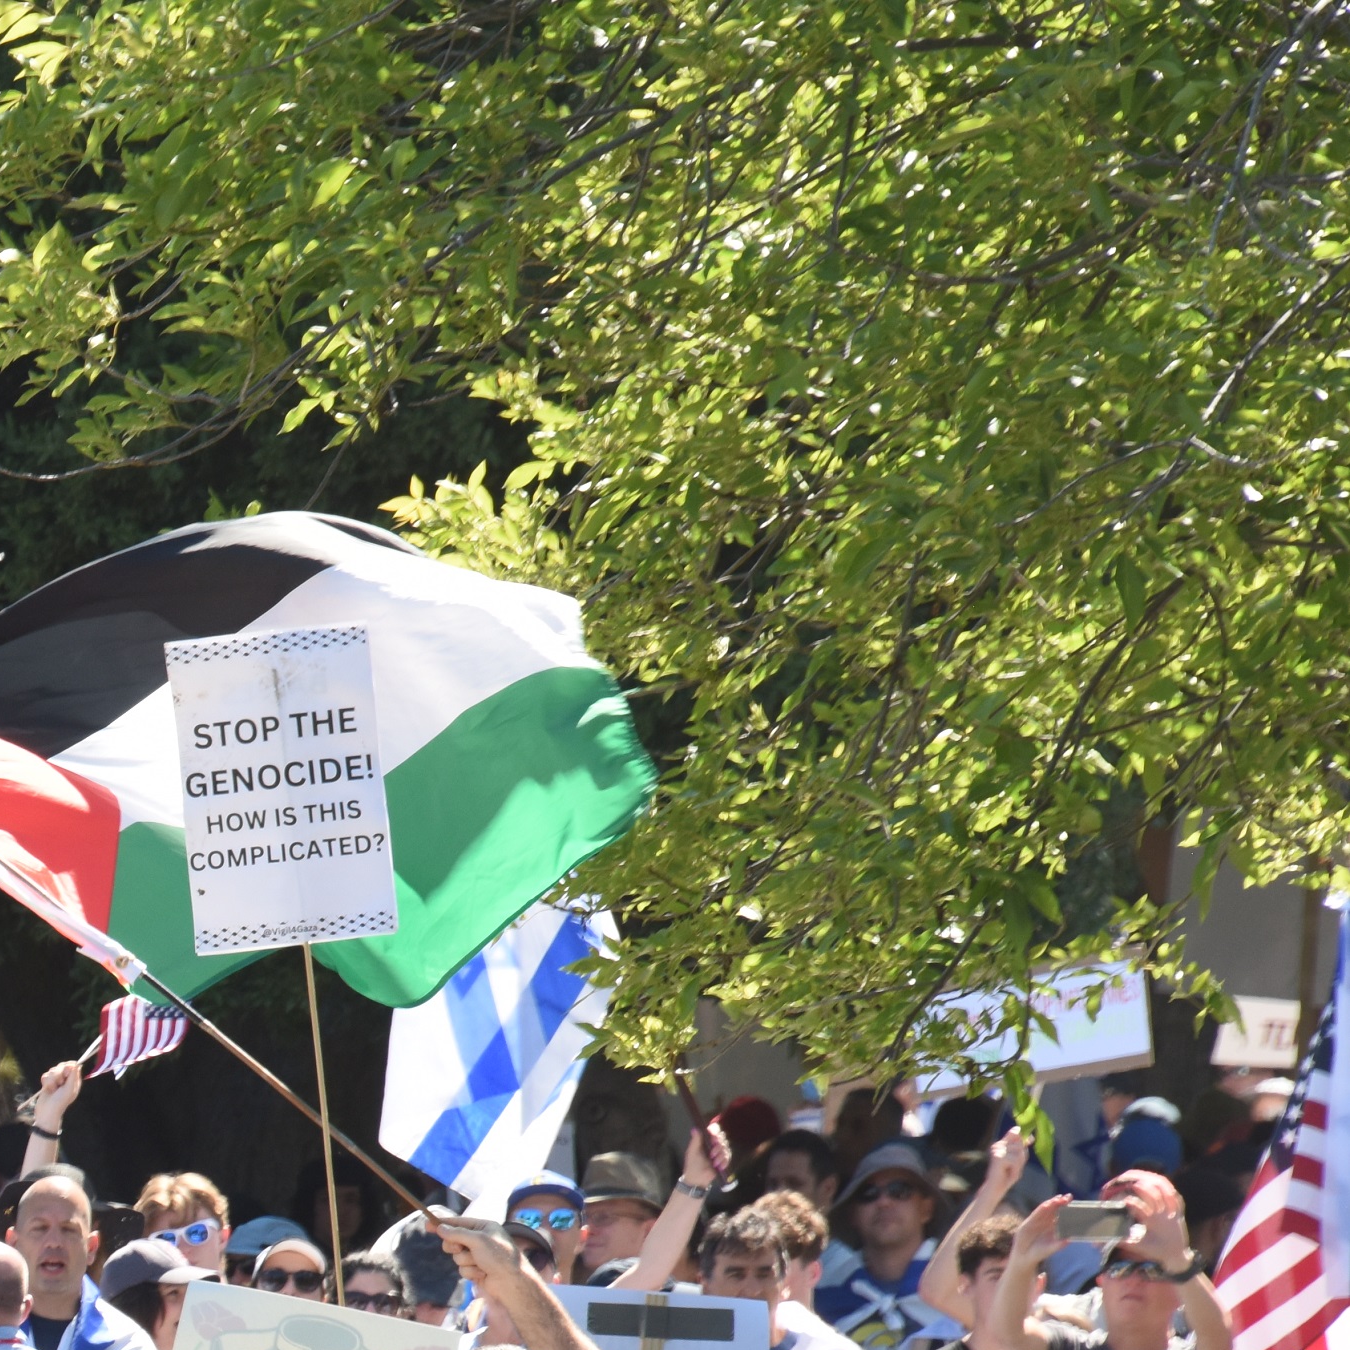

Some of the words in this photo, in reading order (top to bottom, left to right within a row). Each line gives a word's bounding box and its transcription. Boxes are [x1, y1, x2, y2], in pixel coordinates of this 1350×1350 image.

[193, 716, 280, 750] STOP
[289, 707, 358, 738] THE
[186, 753, 374, 798] GENOCIDE!
[206, 809, 267, 834] HOW
[275, 806, 298, 828] IS
[303, 799, 362, 823] THIS
[190, 832, 385, 872] COMPLICATED?
[263, 923, 318, 938] @Vigil4Gaza
